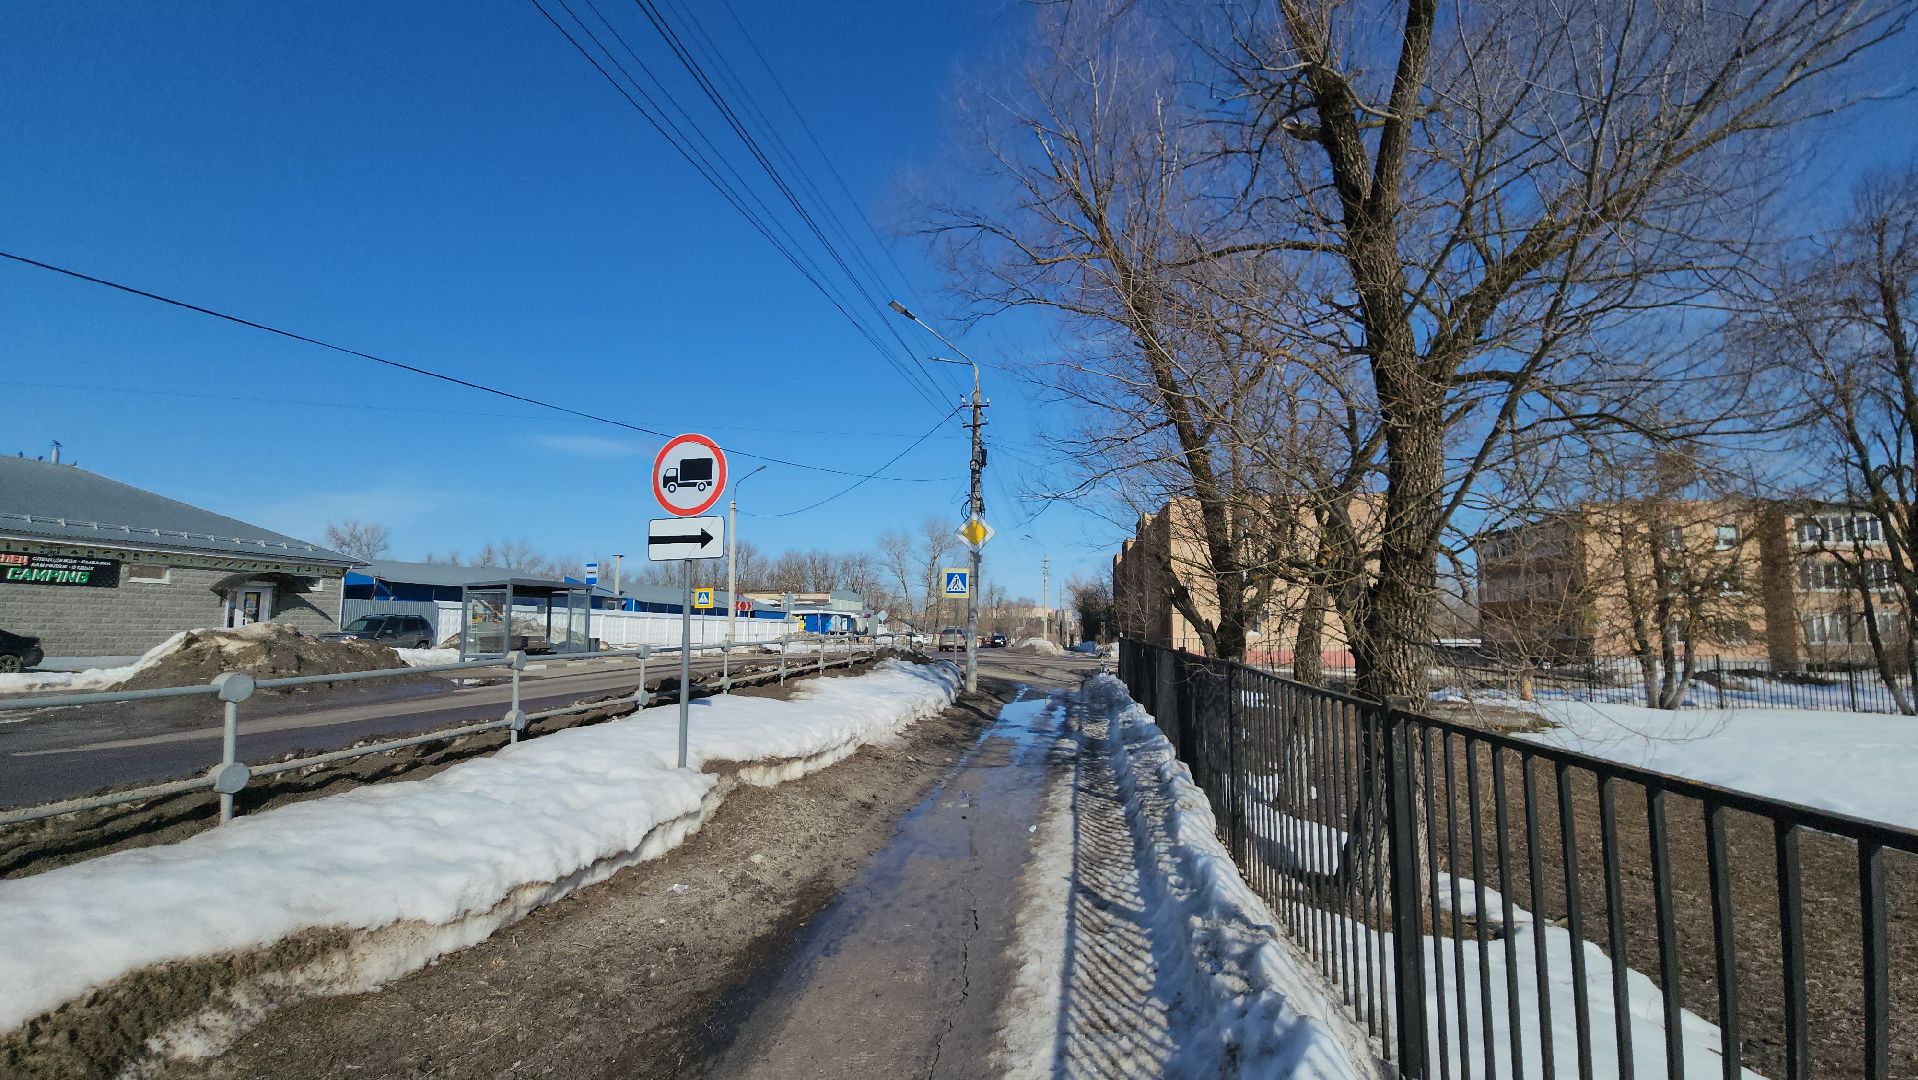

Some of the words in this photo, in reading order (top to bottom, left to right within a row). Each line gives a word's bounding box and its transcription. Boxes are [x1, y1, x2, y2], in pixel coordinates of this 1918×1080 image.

[0, 553, 29, 566] ПЕЦ
[32, 556, 77, 564] СПЕЦОДЕЖДА
[7, 567, 91, 584] CAMPING
